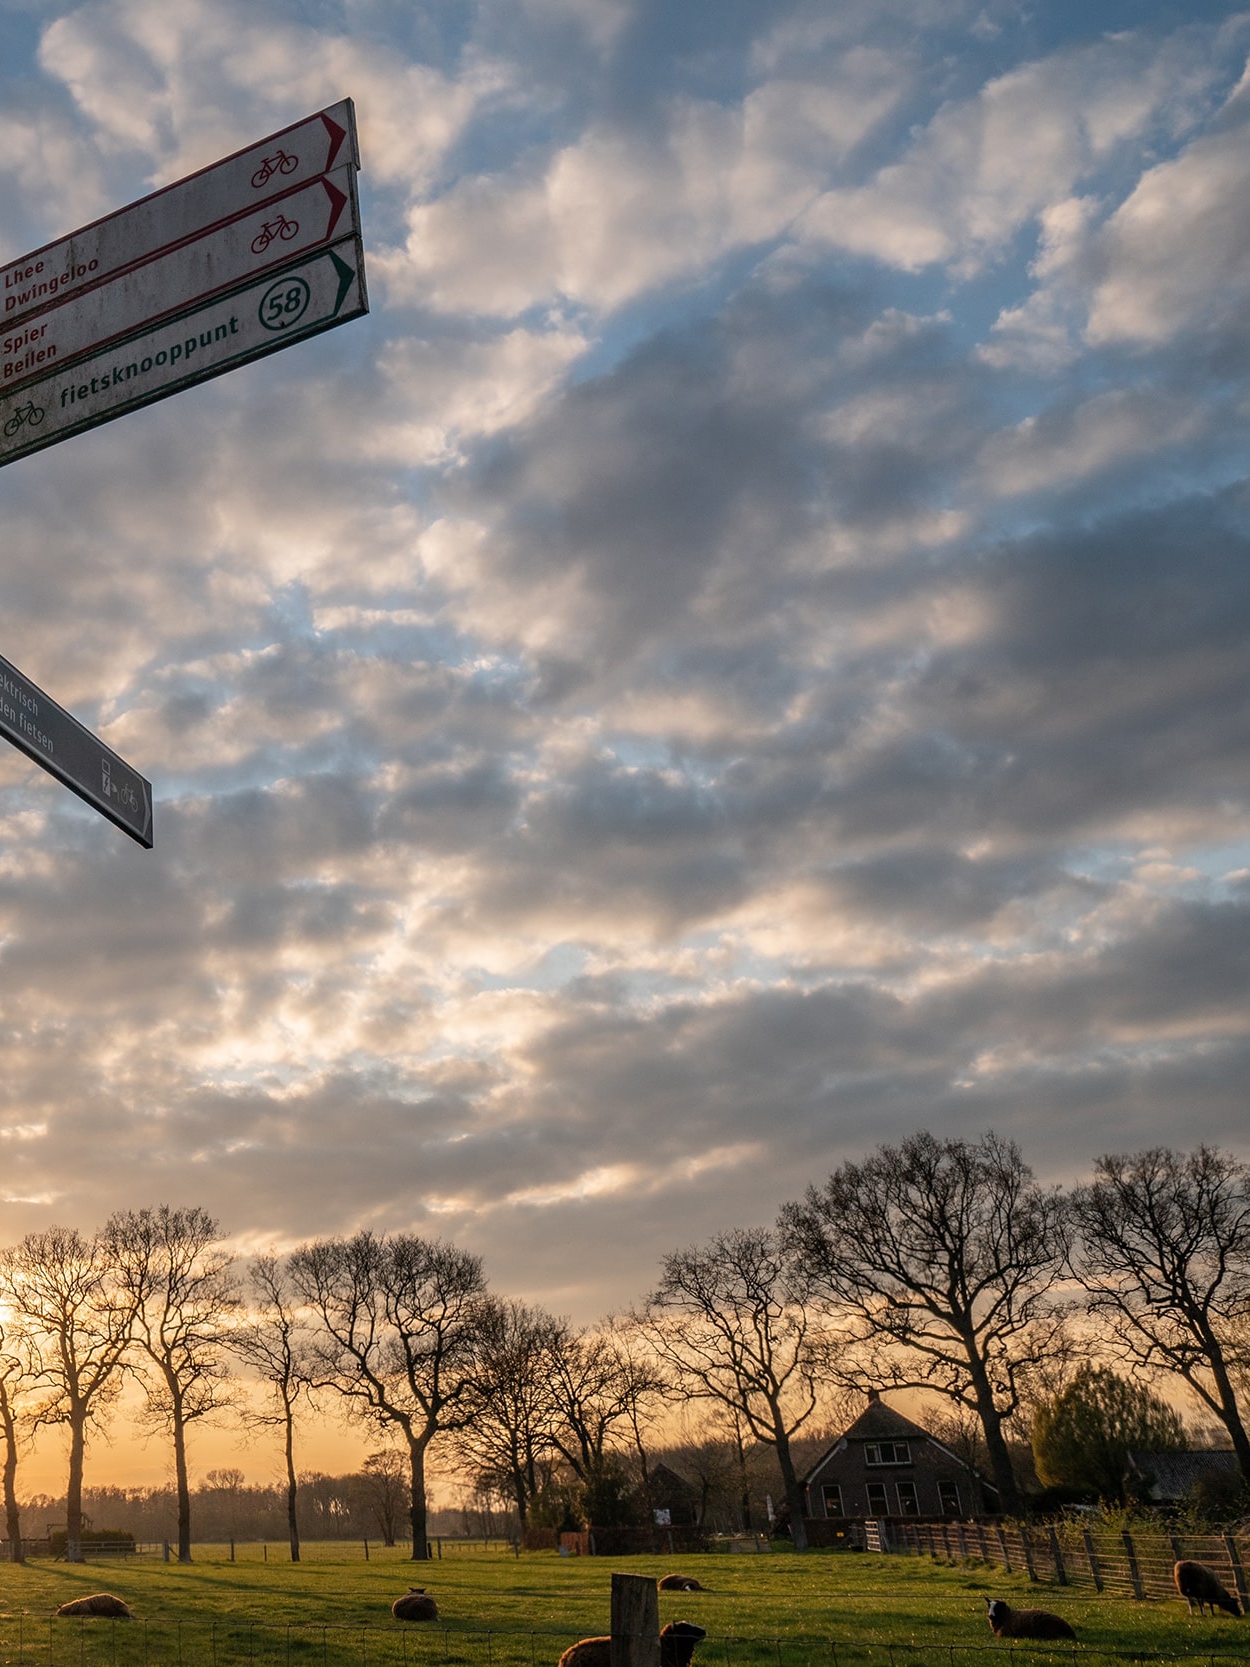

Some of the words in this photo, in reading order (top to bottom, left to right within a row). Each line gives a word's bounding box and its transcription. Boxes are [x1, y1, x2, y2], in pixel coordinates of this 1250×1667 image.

[5, 261, 44, 289] Lhee
[5, 259, 99, 312] Dwingeloo
[2, 323, 48, 355] Spier
[60, 316, 239, 408] fietsknooppunt
[267, 286, 302, 322] 58
[3, 345, 57, 379] Beilen
[19, 712, 54, 753] fietsen
